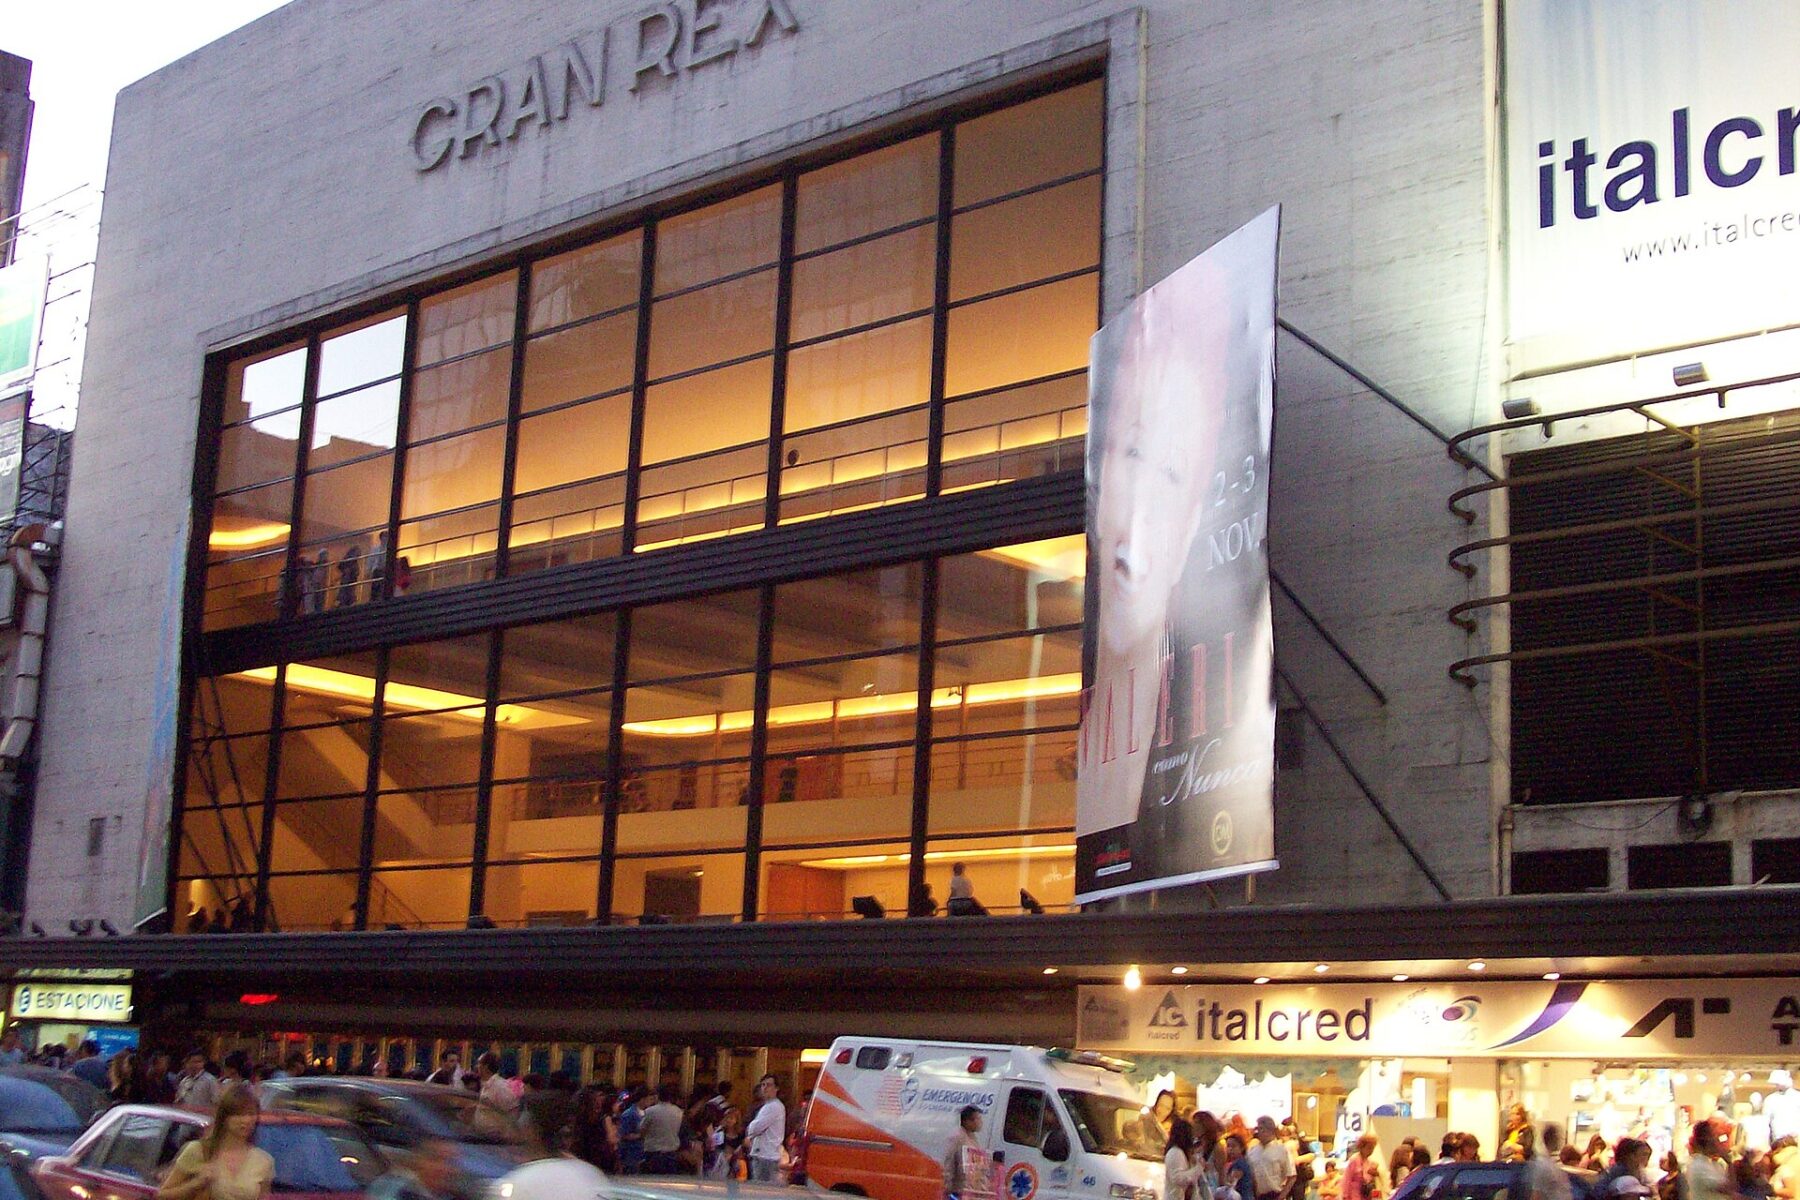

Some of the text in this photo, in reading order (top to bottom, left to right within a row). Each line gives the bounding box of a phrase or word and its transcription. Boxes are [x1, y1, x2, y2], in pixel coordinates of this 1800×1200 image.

[1538, 106, 1800, 229] italcr
[1623, 211, 1800, 264] www.italcre
[36, 991, 125, 1011] ESTACIONE
[1197, 996, 1371, 1043] italcred
[922, 1088, 994, 1107] EMERGENCIAS
